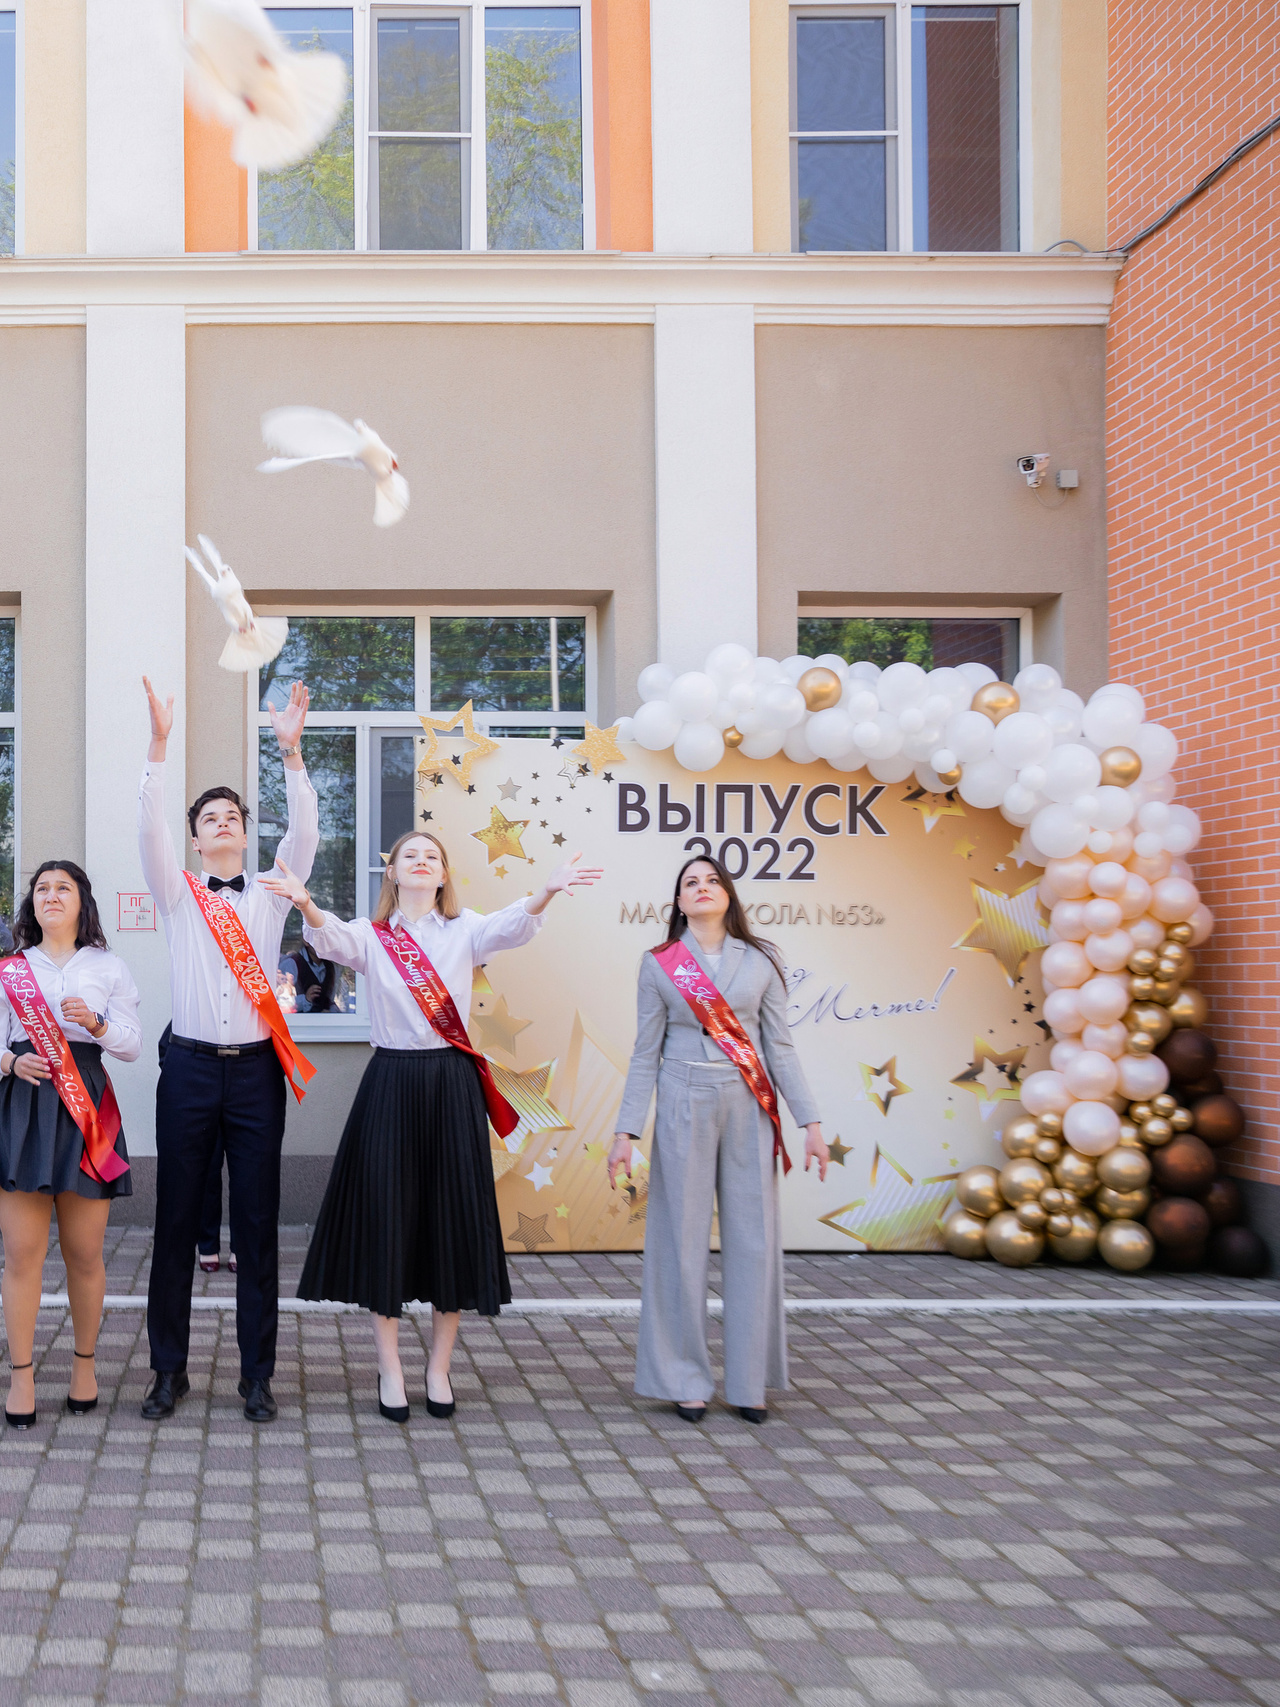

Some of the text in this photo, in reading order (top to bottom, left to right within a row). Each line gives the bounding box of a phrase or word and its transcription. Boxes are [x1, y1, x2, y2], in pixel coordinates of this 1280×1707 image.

[618, 783, 886, 834] ВЫПУСК
[130, 896, 144, 907] ПГ
[620, 901, 885, 925] МАО КОЛА №53»
[233, 954, 269, 998] 2022
[393, 940, 450, 1028] Выпускница
[786, 968, 956, 1028] Мечте!
[11, 977, 63, 1068] Выпускница
[58, 1072, 89, 1113] 2022
